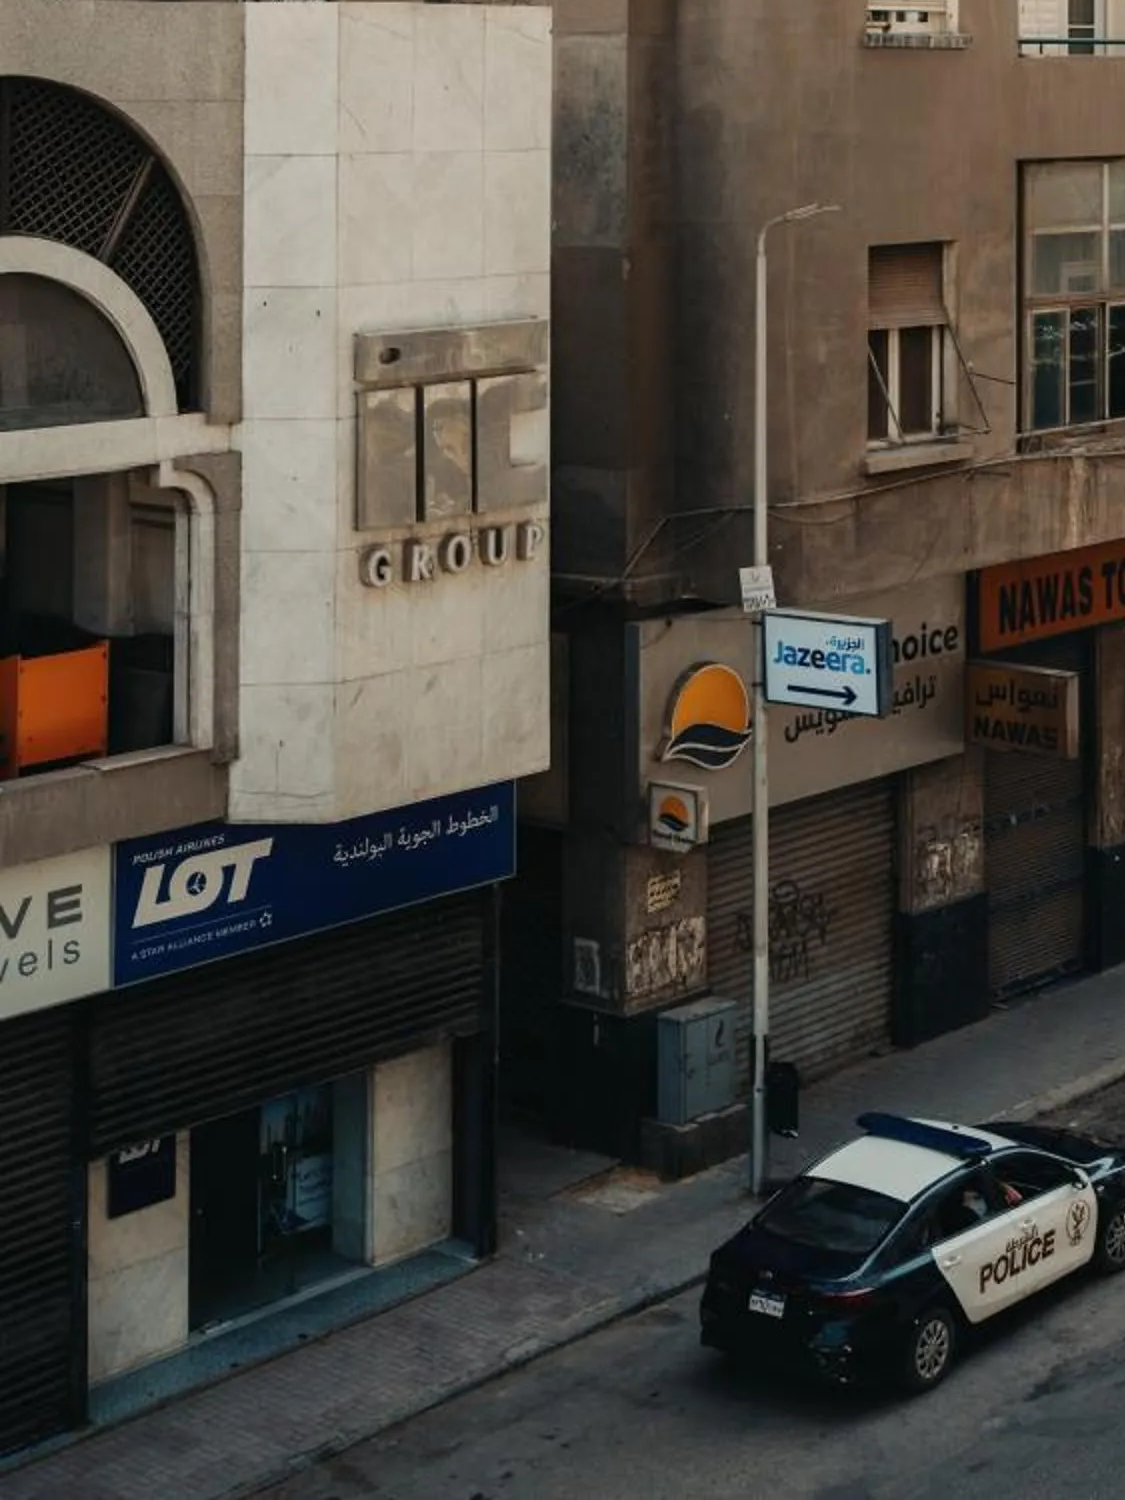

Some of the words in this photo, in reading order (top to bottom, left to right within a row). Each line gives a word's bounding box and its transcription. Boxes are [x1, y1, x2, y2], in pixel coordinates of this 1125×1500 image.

[359, 518, 544, 589] GROUP
[999, 564, 1093, 636] NAWAS
[973, 714, 1058, 748] NAWAS
[396, 819, 441, 851] الجوية
[445, 804, 499, 837] الخطوط
[131, 845, 174, 866] POLISH
[175, 832, 225, 855] AIRLINES
[332, 832, 394, 867] البولندية
[131, 836, 275, 930] LOT
[979, 1228, 1056, 1294] POLICE
